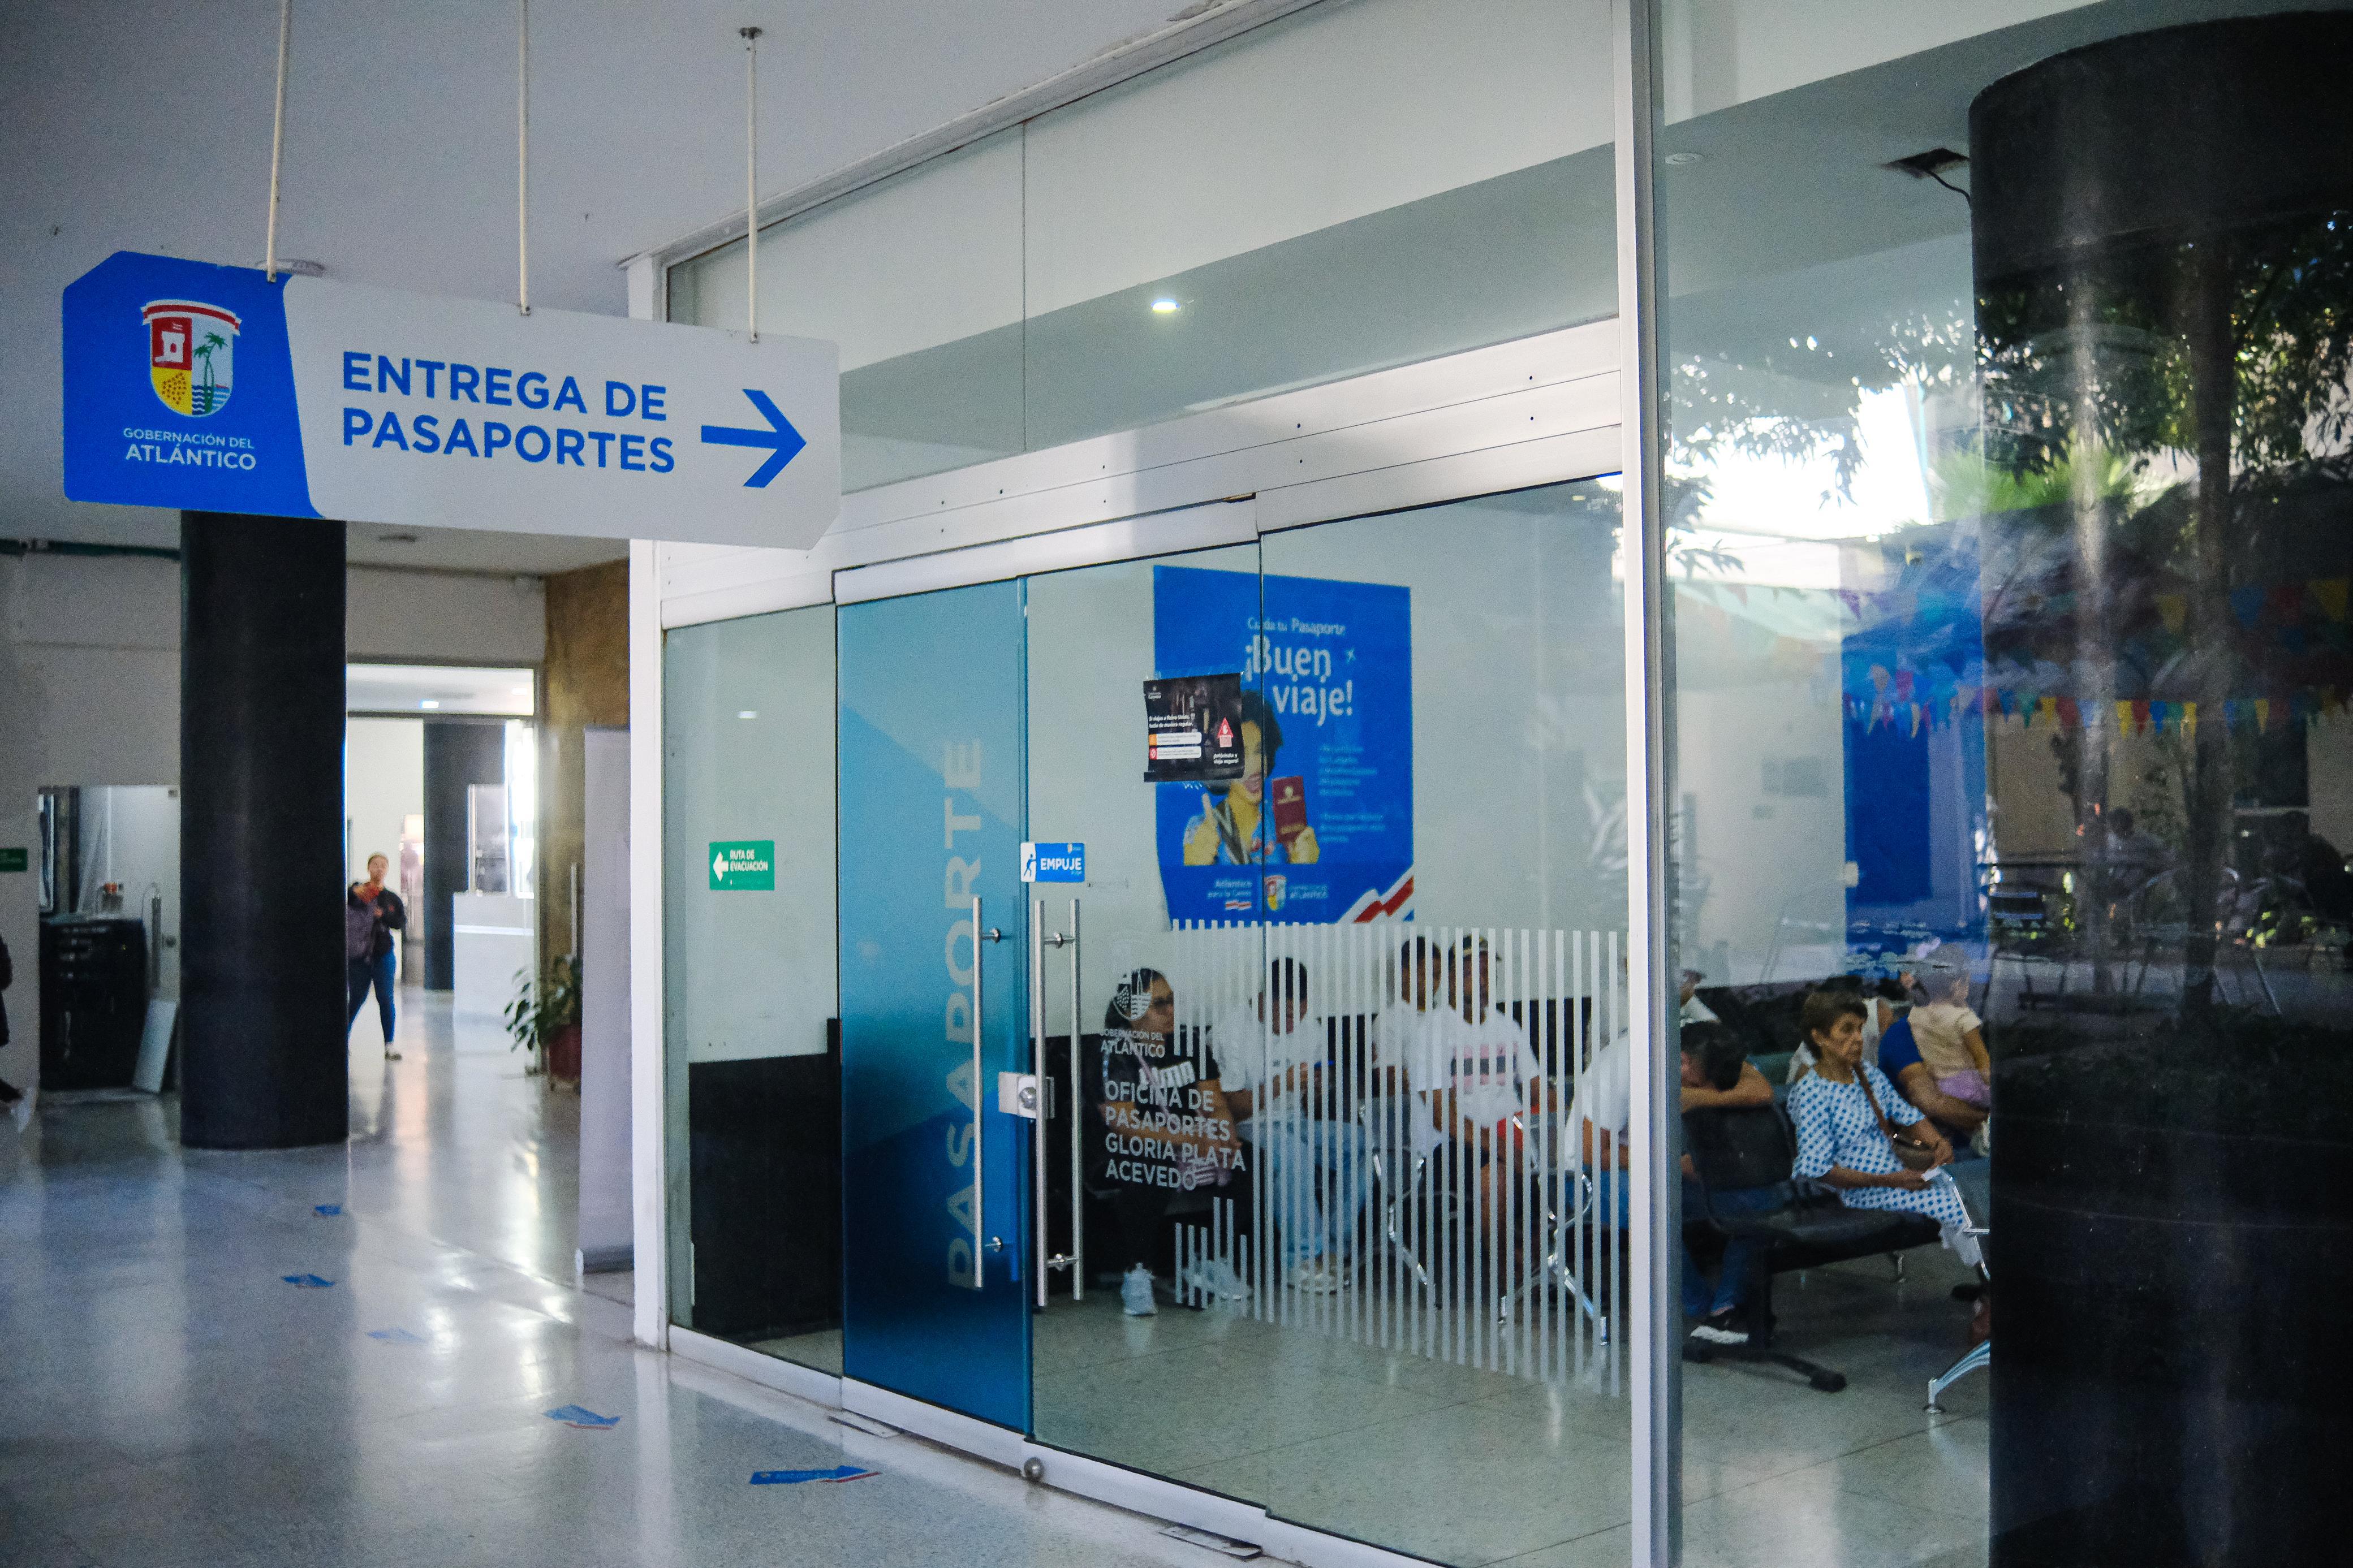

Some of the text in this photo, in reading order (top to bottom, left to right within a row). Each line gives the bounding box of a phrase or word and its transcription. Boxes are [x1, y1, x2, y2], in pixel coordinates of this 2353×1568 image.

[343, 351, 667, 421] ENTREGA DE
[123, 427, 254, 449] GOBERNACIÓN DEL
[343, 407, 675, 474] PASAPORTES
[126, 443, 256, 470] ATLÁNTICO
[1291, 617, 1346, 637] Pasaporte
[1246, 634, 1331, 682] ¡Buen
[1273, 674, 1353, 727] viaje!
[730, 849, 755, 860] RUTA DE
[730, 859, 768, 871] EVACUACIÓN
[1040, 857, 1081, 870] EMPUJE
[944, 740, 982, 1291] PASAPORTE
[1105, 1081, 1214, 1112] OFICINA DE
[1105, 1106, 1231, 1141] PASAPORTES
[1105, 1133, 1246, 1172] GLORIA PLATA
[1105, 1159, 1196, 1191] ACEVEDO
